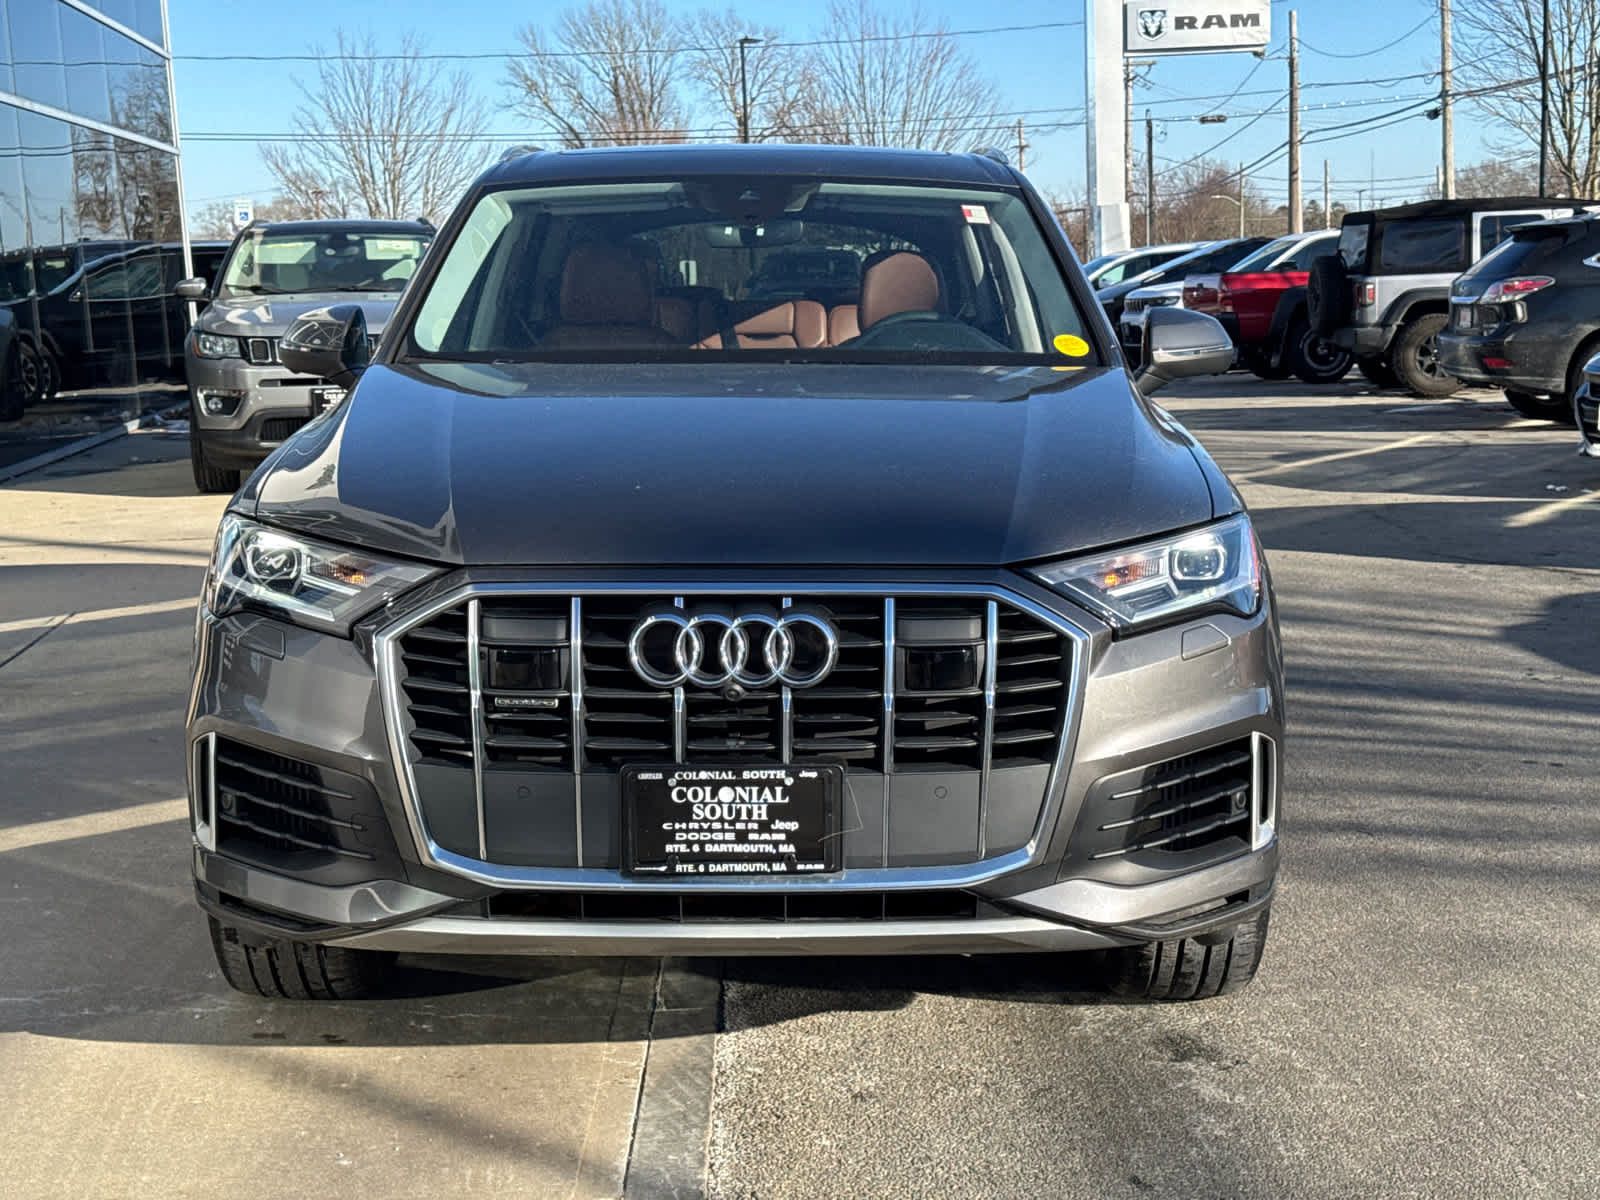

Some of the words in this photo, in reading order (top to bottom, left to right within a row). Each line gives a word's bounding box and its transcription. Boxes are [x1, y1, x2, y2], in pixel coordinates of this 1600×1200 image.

[1174, 13, 1260, 30] RAM
[674, 770, 736, 780] COLONIAL
[742, 770, 786, 779] SOUTH
[671, 786, 789, 803] COLONIAL
[692, 803, 769, 820] SOUTH
[662, 822, 759, 830] CHRYSLER
[770, 820, 799, 832] Jeep
[675, 832, 736, 841] DODGE
[748, 832, 787, 841] RAM
[665, 844, 690, 853] RTE.
[692, 844, 700, 853] 6
[705, 844, 777, 854] DARTMOUTH,
[778, 844, 796, 853] MA
[676, 864, 697, 873] RTE.
[698, 864, 705, 873] 6
[709, 863, 771, 873] DARTMOUTH,
[772, 863, 787, 872] MA
